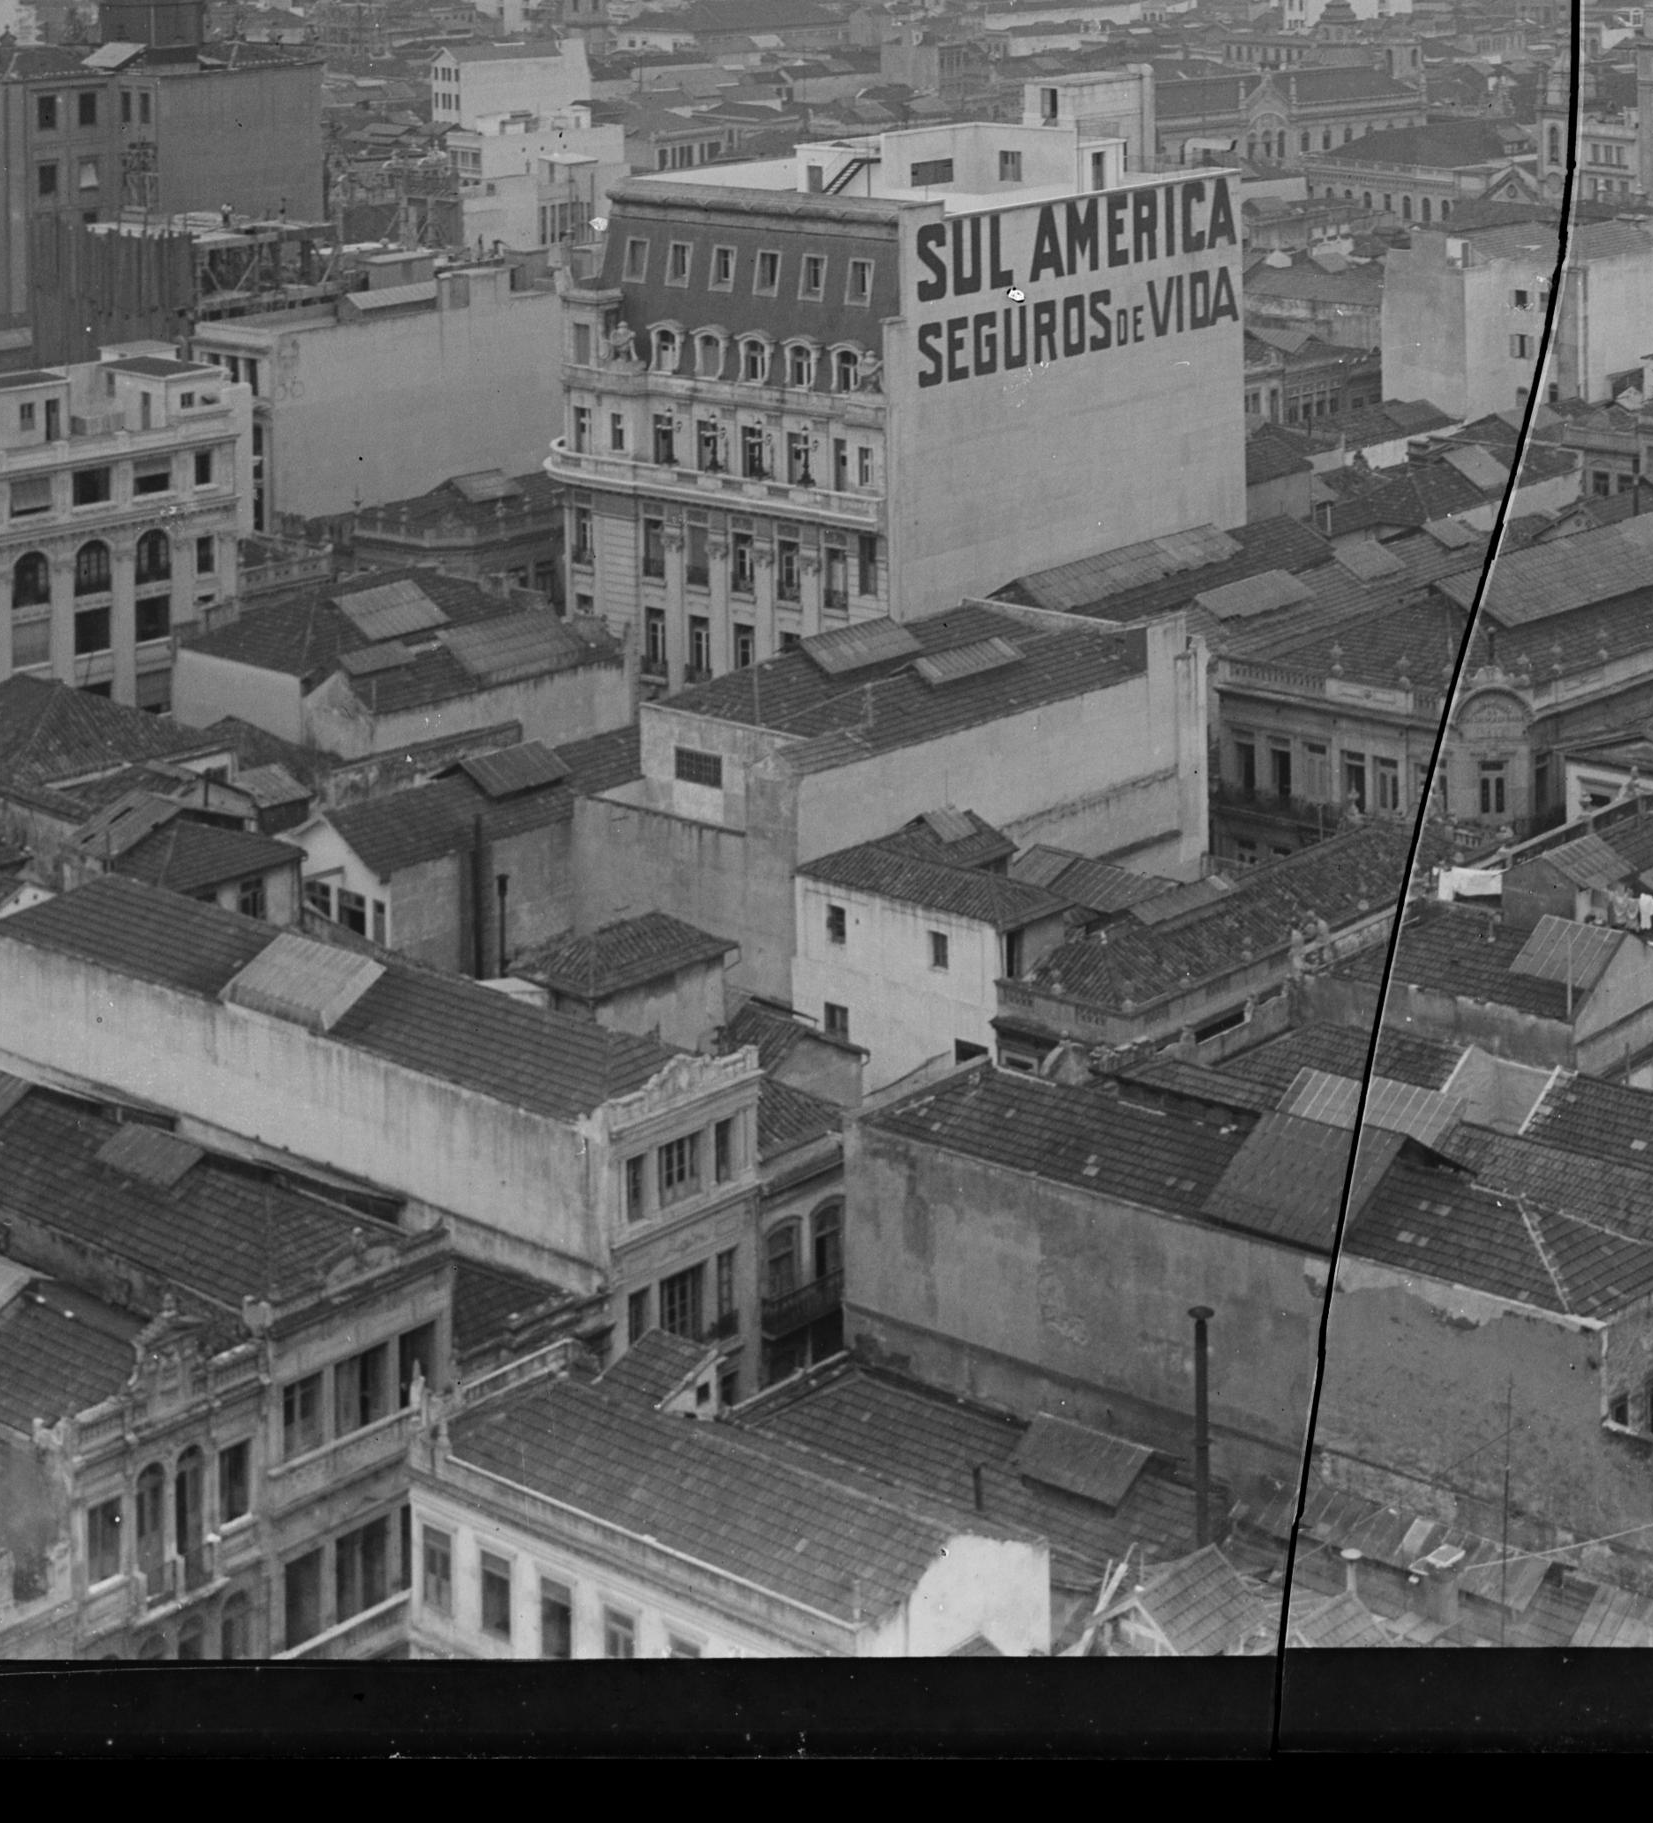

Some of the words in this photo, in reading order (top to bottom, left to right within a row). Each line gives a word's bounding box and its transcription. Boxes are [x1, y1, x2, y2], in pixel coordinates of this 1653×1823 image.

[917, 213, 1013, 302] SUL
[1029, 177, 1237, 282] AMERICA
[917, 289, 1112, 388] SEGUROS
[1117, 305, 1144, 346] DE
[1147, 266, 1239, 338] VIDA
